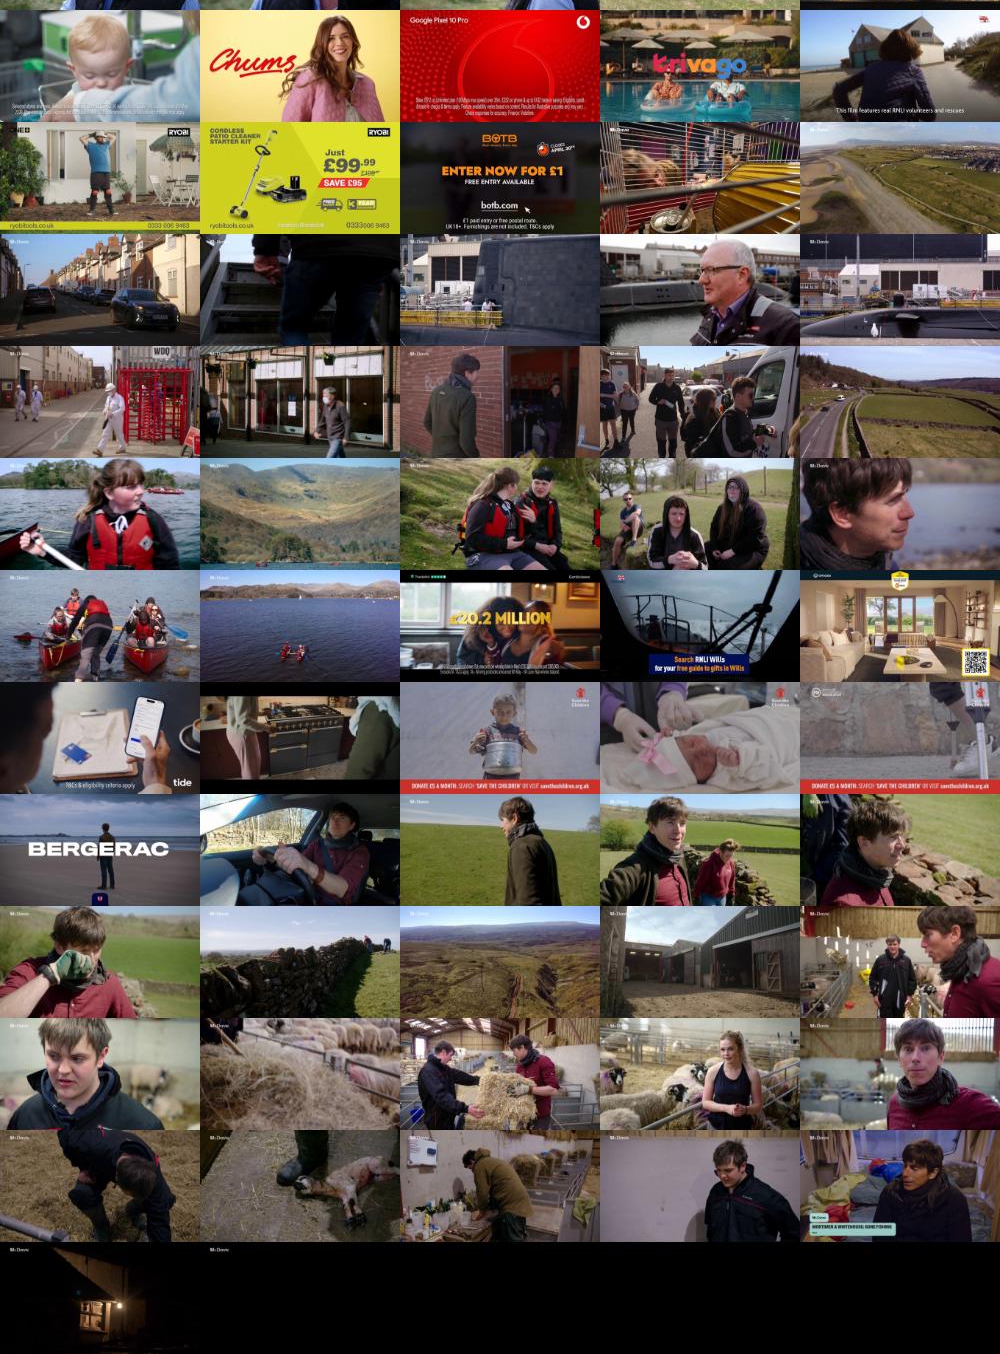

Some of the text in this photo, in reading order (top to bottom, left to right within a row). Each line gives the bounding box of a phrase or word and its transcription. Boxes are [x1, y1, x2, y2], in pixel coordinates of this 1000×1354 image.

[210, 48, 297, 73] Chums
[482, 134, 517, 142] BOTB
[441, 166, 564, 176] ENTER NOW FOR £1
[481, 201, 518, 209] botb.com
[496, 612, 550, 625] MILLION
[28, 842, 169, 856] BERGERAC
